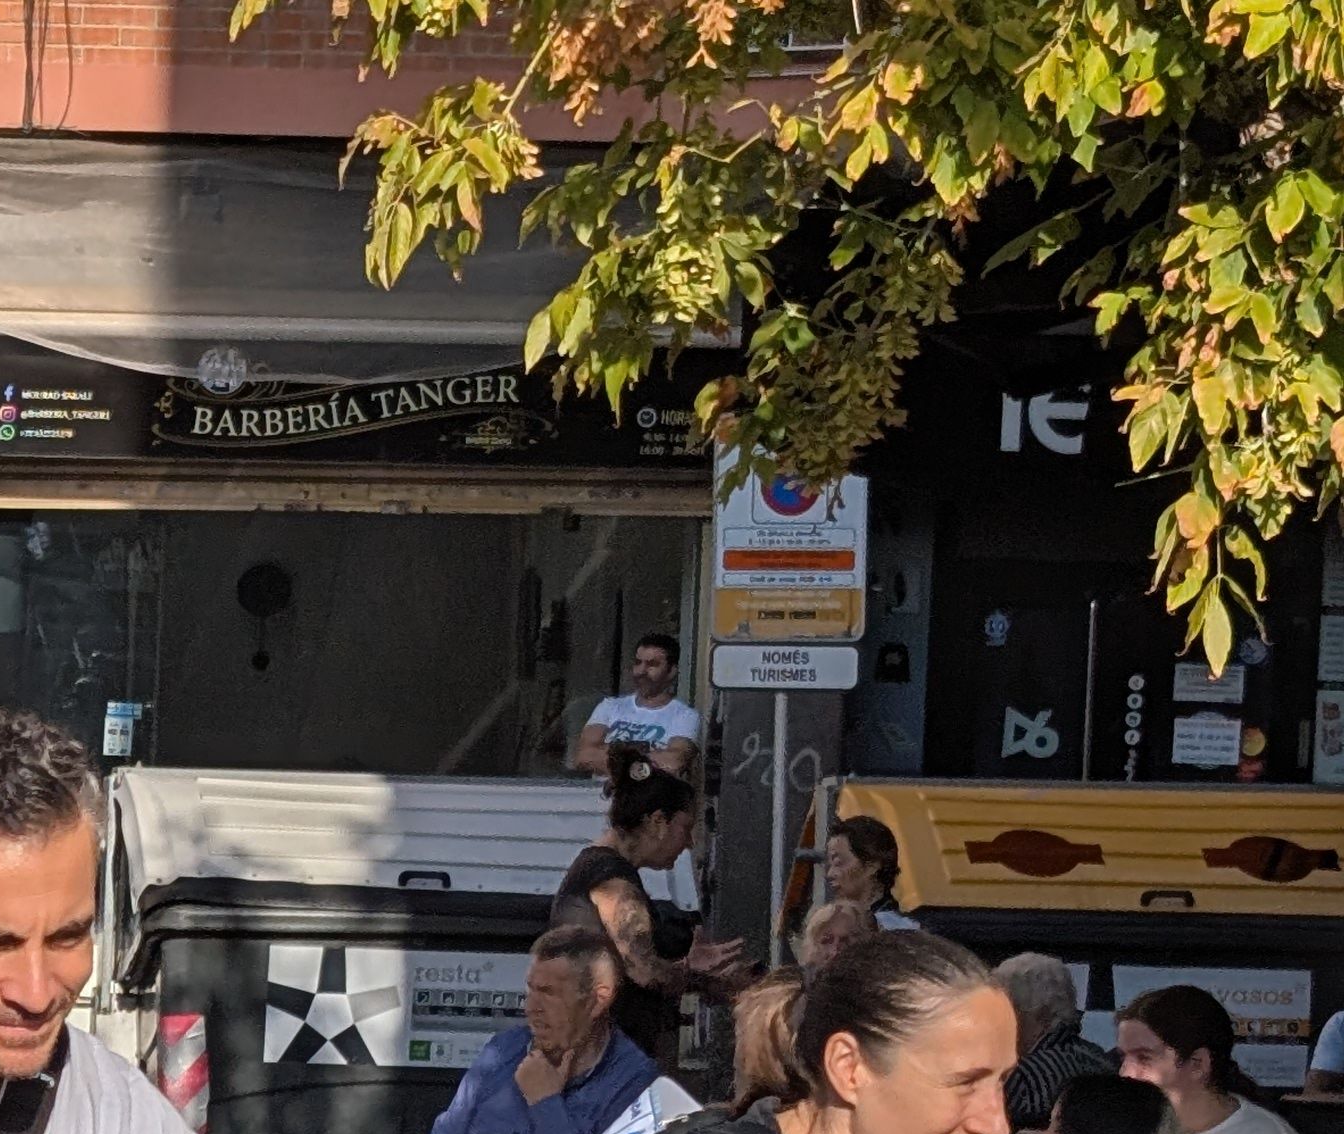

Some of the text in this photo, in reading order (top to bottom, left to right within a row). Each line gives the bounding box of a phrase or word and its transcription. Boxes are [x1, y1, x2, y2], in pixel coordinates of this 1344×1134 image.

[191, 374, 521, 438] BARBERÍA TANGER
[762, 649, 810, 665] NOMÉS
[750, 667, 818, 682] TURISMES
[414, 964, 483, 984] resta
